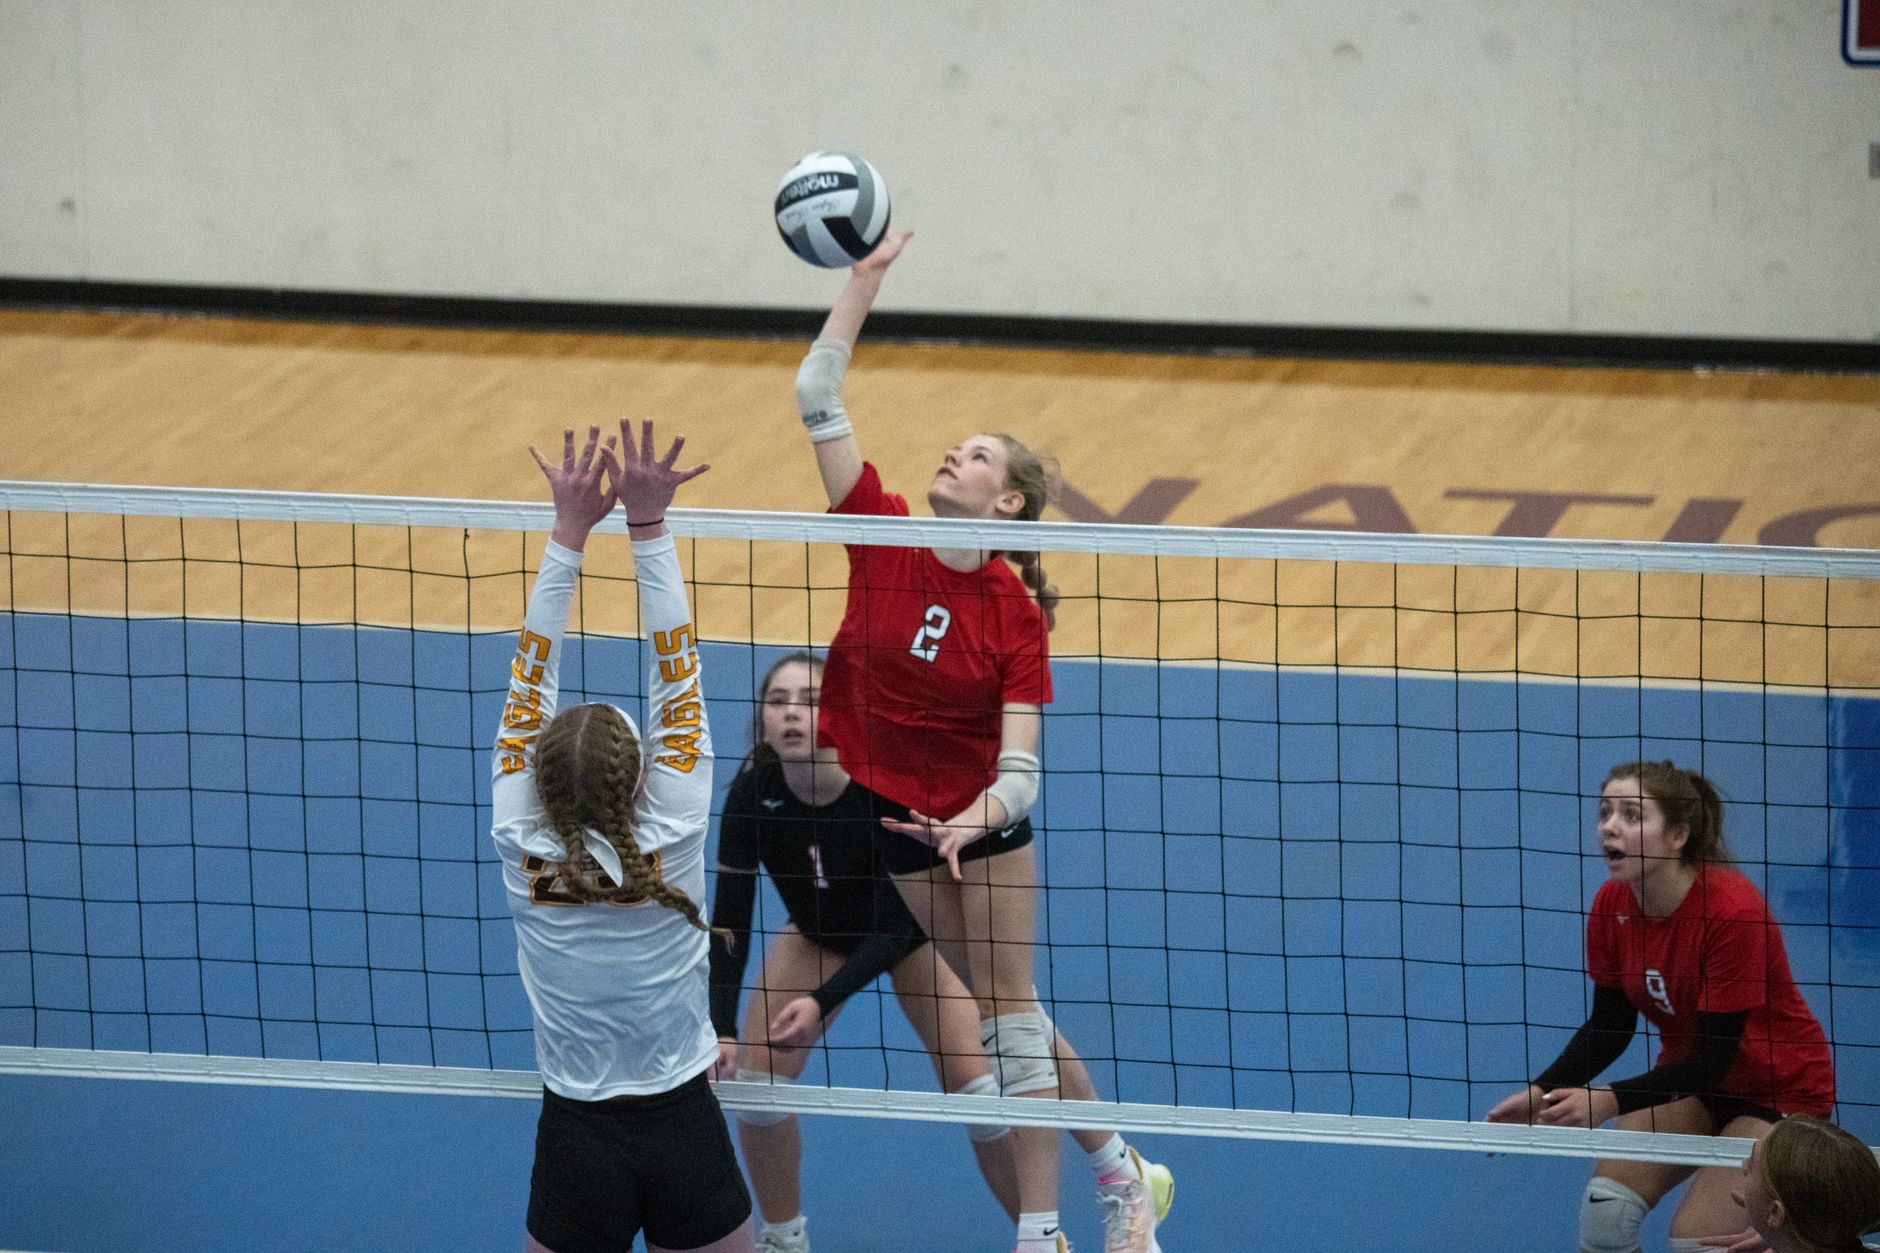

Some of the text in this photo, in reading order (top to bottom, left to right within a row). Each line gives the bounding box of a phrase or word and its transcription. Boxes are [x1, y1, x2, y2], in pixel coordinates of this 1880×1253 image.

[909, 604, 951, 663] 2
[653, 622, 704, 774] EAGLES
[808, 845, 829, 889] 1
[1645, 968, 1676, 1016] 9
